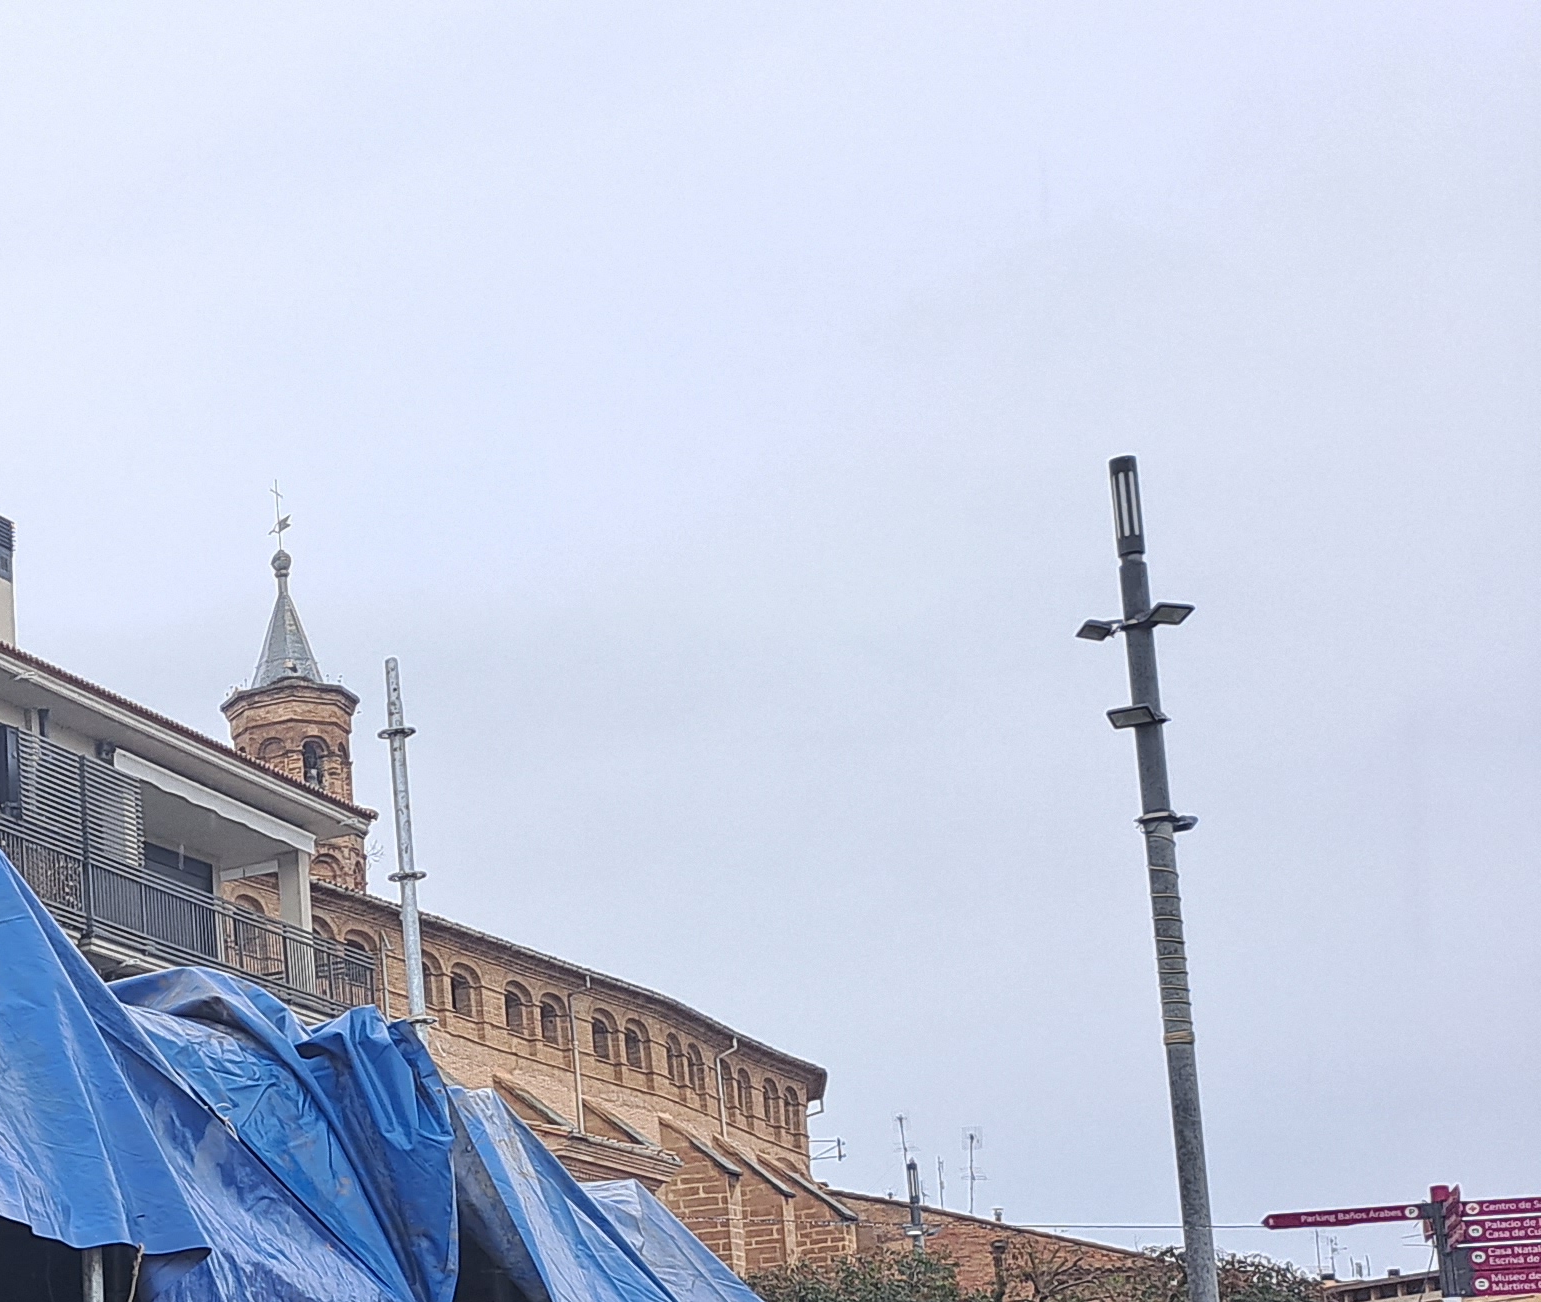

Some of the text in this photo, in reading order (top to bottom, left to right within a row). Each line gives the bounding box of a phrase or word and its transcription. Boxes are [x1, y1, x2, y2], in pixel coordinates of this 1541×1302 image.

[1482, 1202, 1516, 1211] Centro
[1518, 1201, 1531, 1209] de
[1300, 1214, 1336, 1223] Parking
[1337, 1212, 1367, 1220] Baños
[1485, 1220, 1521, 1229] Palacio
[1523, 1219, 1536, 1227] de
[1485, 1229, 1510, 1238] Casa
[1512, 1229, 1525, 1237] de
[1487, 1247, 1512, 1255] Casa
[1489, 1255, 1540, 1265] Escrivá de
[1491, 1273, 1526, 1282] Museo
[1492, 1282, 1537, 1291] Mártires
